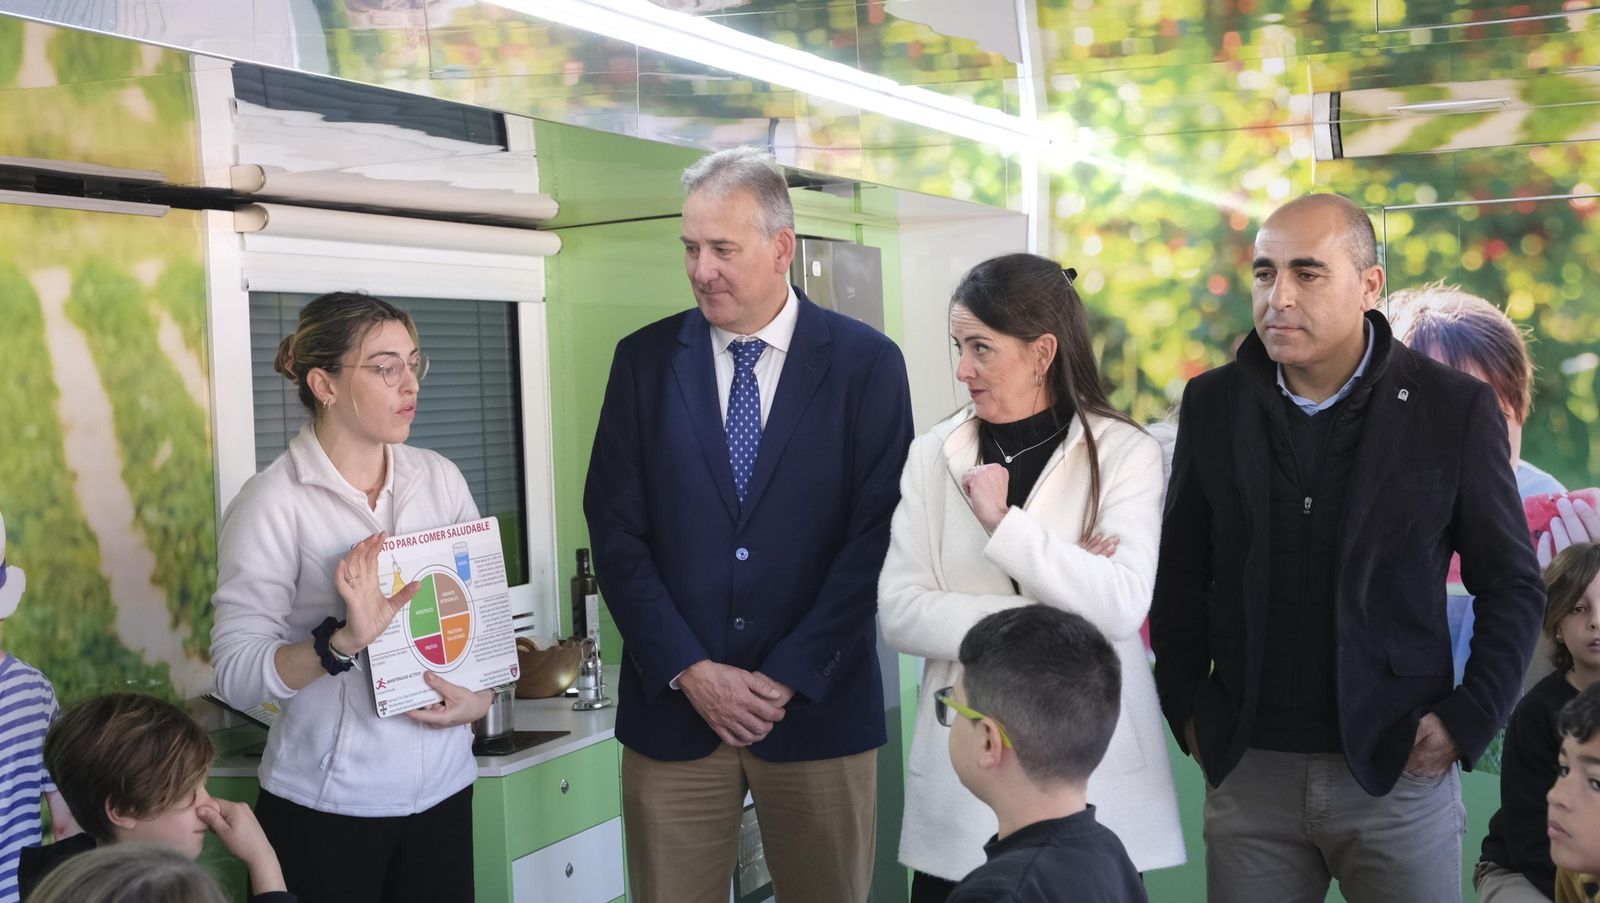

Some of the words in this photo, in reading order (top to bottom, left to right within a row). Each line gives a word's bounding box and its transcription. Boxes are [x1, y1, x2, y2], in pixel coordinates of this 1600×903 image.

[379, 541, 395, 552] ATO
[396, 537, 418, 549] PARA
[418, 530, 447, 544] COMER
[447, 521, 490, 538] SALUDABLE
